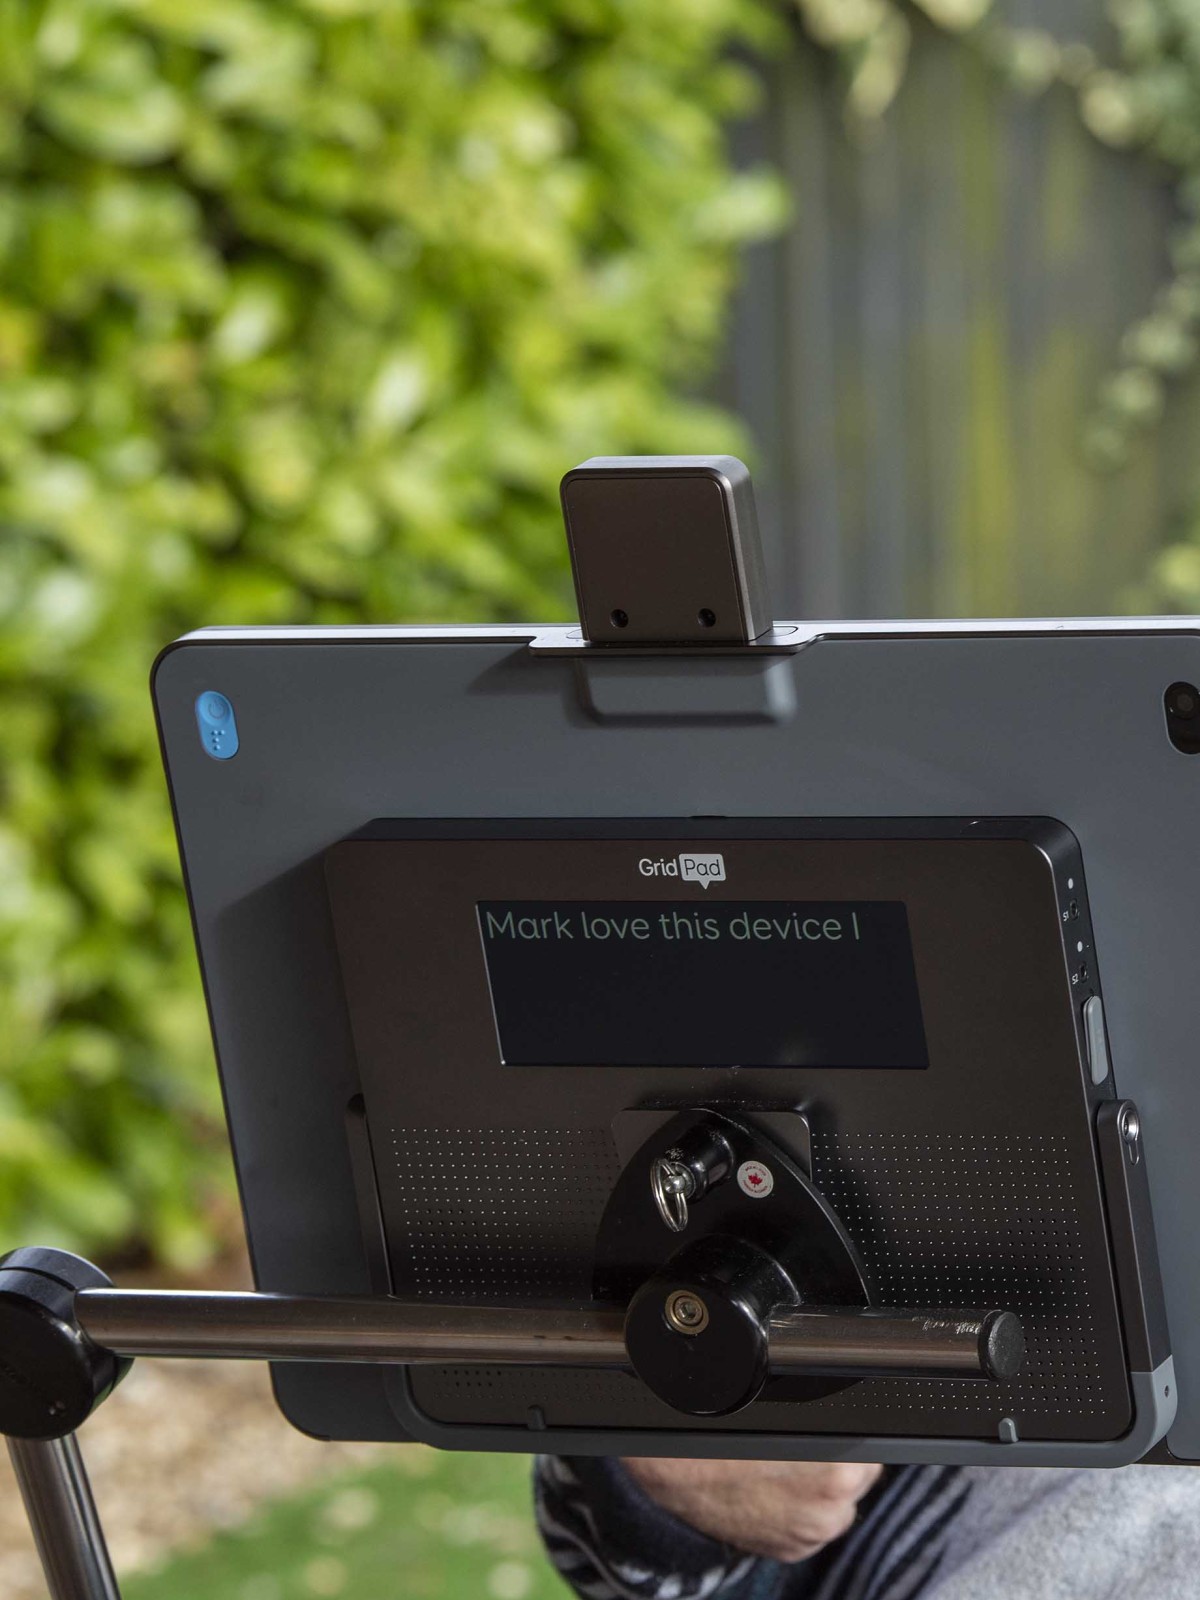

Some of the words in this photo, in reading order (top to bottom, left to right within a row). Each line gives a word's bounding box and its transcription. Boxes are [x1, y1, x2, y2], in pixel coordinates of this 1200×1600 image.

[486, 911, 574, 939] Mark
[581, 911, 650, 939] love
[659, 911, 720, 939] this
[729, 911, 842, 940] device
